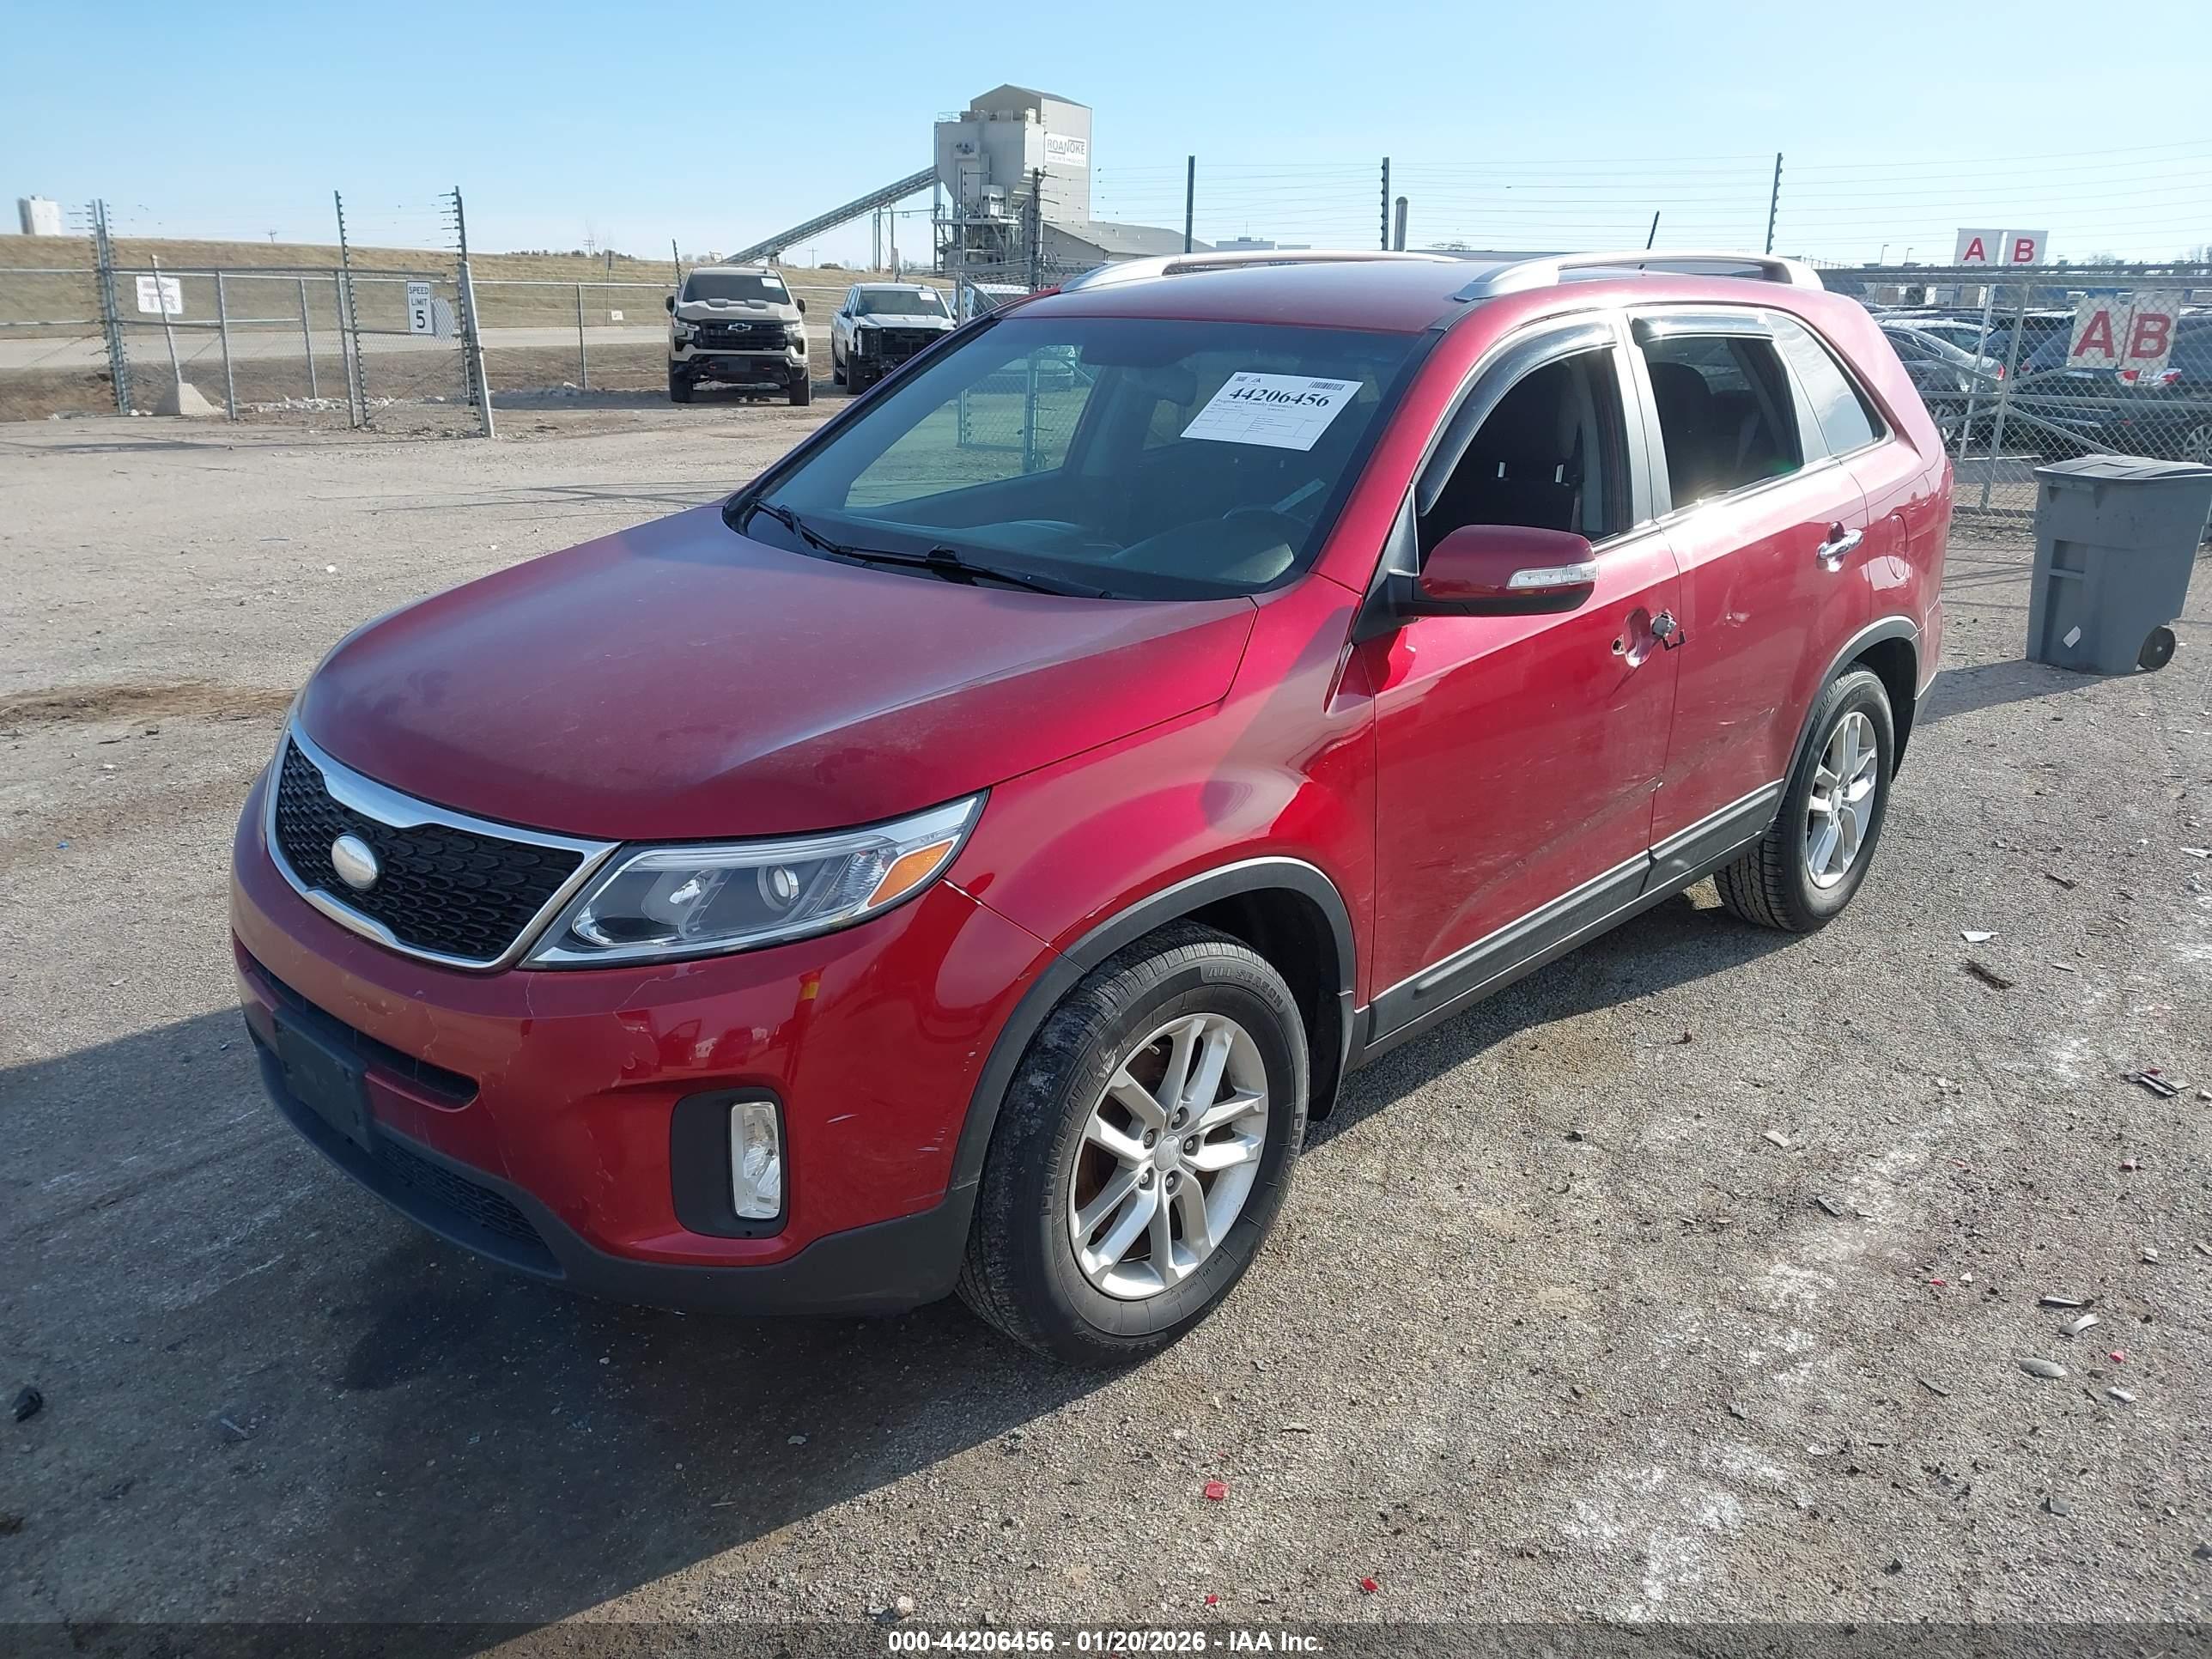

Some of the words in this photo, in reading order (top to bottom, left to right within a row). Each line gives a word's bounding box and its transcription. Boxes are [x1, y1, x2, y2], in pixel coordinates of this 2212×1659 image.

[1047, 138, 1085, 155] ROANOKE
[1963, 237, 1986, 261] A
[2014, 239, 2035, 263] B
[409, 286, 428, 295] SPEED
[410, 298, 427, 307] LIMIT
[416, 309, 425, 329] 5
[2072, 310, 2115, 358] A
[2130, 313, 2171, 358] B
[1229, 386, 1334, 408] 44206456
[1207, 965, 1234, 977] ALL
[1236, 969, 1283, 1008] SEASON
